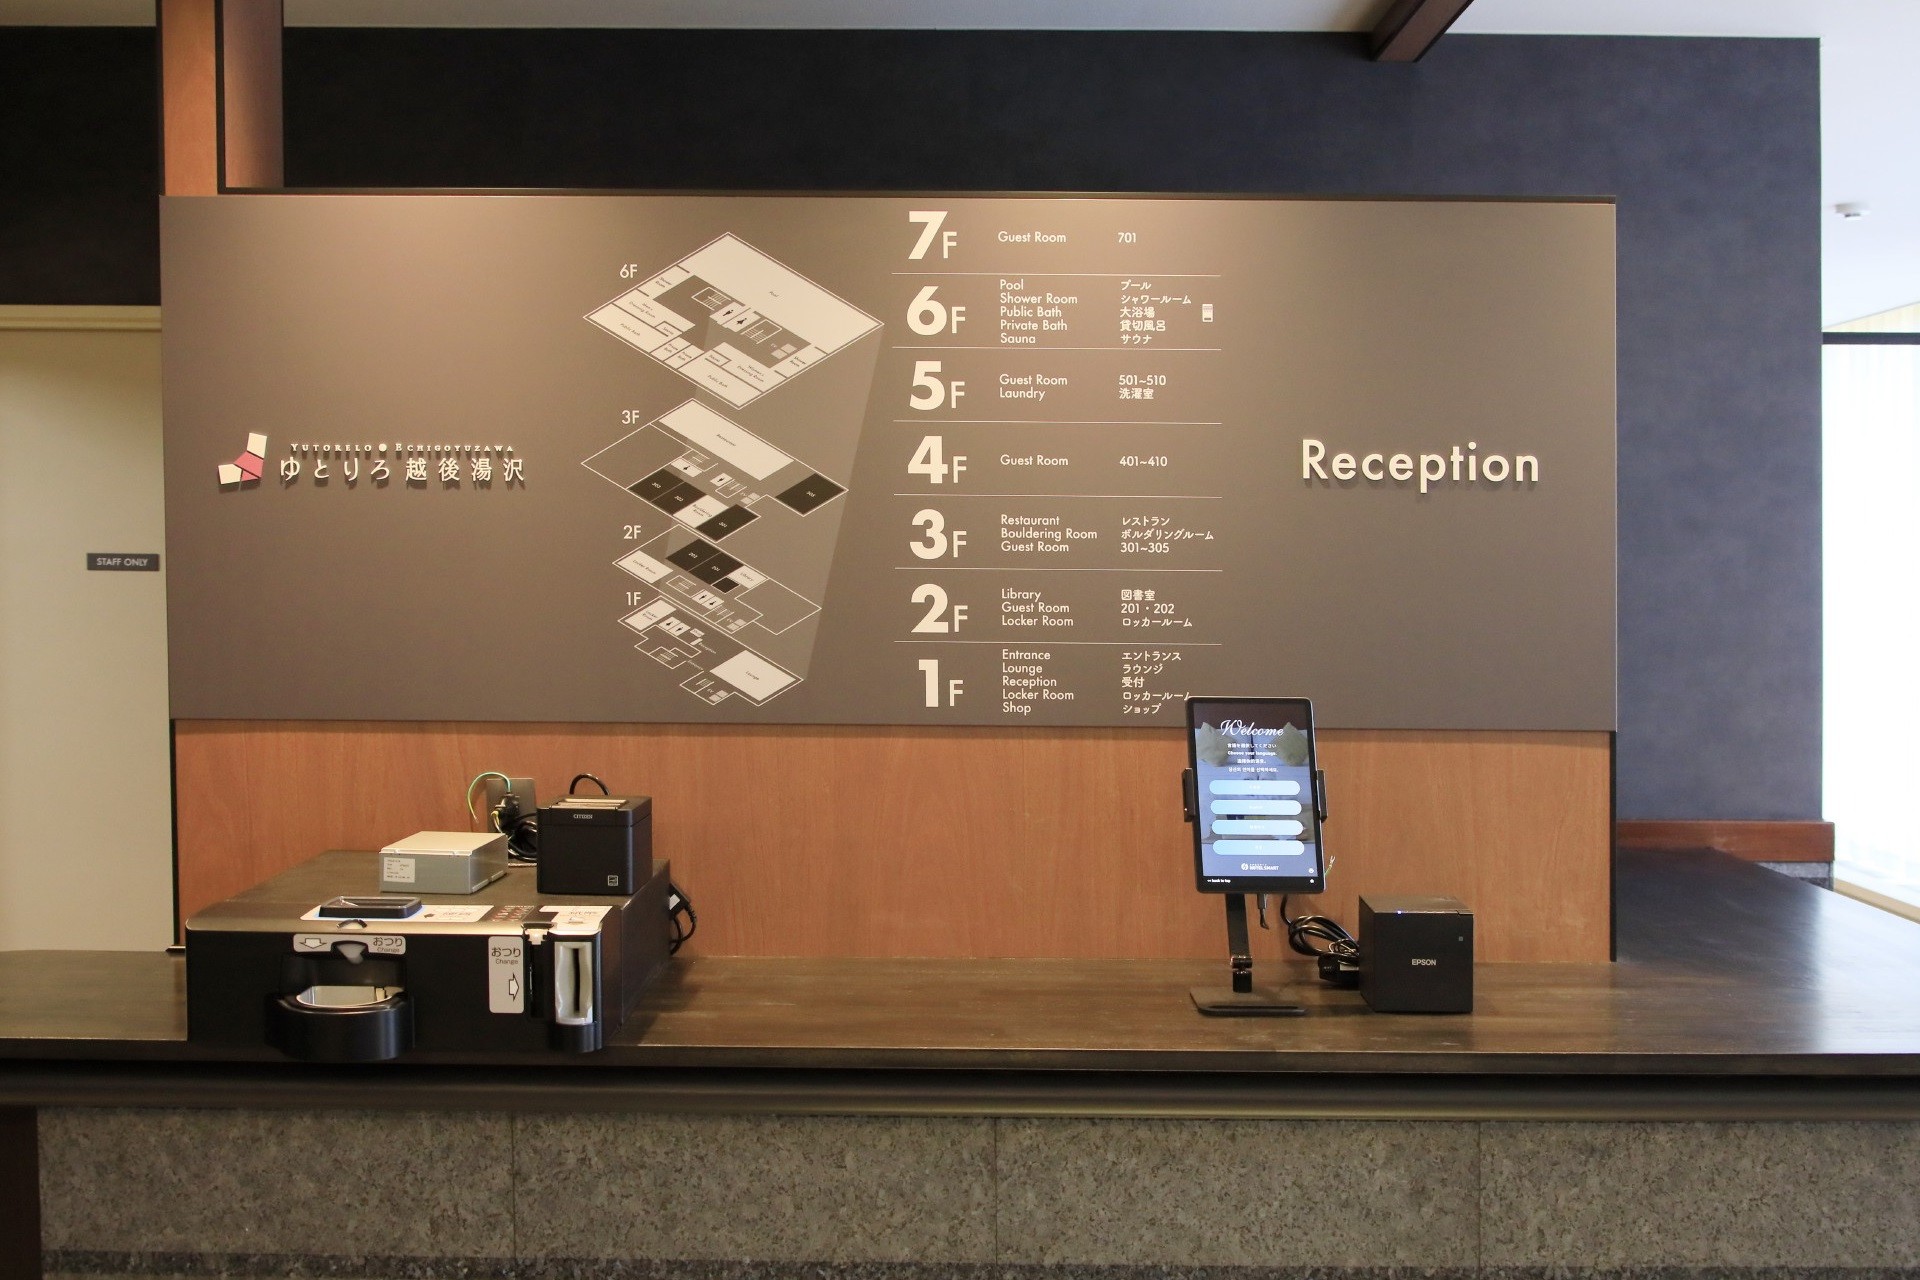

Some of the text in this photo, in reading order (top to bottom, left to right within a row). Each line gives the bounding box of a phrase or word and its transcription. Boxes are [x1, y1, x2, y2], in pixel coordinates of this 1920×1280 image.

[908, 211, 957, 259] 7F
[998, 231, 1066, 242] Guest Room
[1118, 232, 1136, 243] 701
[620, 264, 637, 278] 6F
[1000, 279, 1023, 290] Pool
[1121, 279, 1151, 290] プール
[1000, 292, 1077, 303] Shower Room
[1121, 295, 1191, 304] シャワールーム
[907, 286, 965, 335] 6F
[1001, 305, 1062, 317] Public Bath
[1120, 306, 1155, 318] 大浴場
[1001, 319, 1067, 330] Private Bath
[1120, 319, 1165, 331] 貸切風呂
[1001, 333, 1035, 343] Sauna
[1121, 334, 1152, 344] サウナ
[1000, 374, 1067, 385] Guest Room
[910, 361, 965, 410] 5F
[1000, 387, 1045, 401] Laundry
[1119, 388, 1153, 399] 洗濯室
[622, 410, 639, 424] 3F
[908, 436, 967, 483] 4F
[1001, 454, 1068, 465] Guest Room
[1302, 439, 1539, 493] Reception
[1001, 514, 1059, 525] Restaurant
[1123, 516, 1169, 526] レストラン
[624, 525, 641, 539] 2F
[910, 509, 966, 559] 3F
[1002, 527, 1097, 542] Bouldering Room
[1121, 528, 1213, 540] ボルダリングルーム
[1001, 540, 1069, 552] Guest Room
[96, 558, 148, 566] STAFF ONLY
[626, 592, 641, 606] 1F
[1002, 588, 1042, 603] Library
[1121, 589, 1155, 600] 図書室
[911, 584, 968, 633] 2F
[1002, 601, 1069, 612] Guest Room
[1002, 614, 1073, 626] Locker Room
[1123, 617, 1192, 627] ロッカールーム
[1003, 649, 1050, 659] Entrance
[1122, 651, 1181, 661] エントランス
[1003, 662, 1042, 677] Lounge
[1123, 663, 1163, 674] ラウンジ
[919, 659, 963, 707] 1F
[1003, 675, 1056, 690] Reception
[1122, 677, 1144, 687] 受付
[1003, 688, 1073, 699] Locker Room
[1003, 702, 1031, 715] Shop
[1123, 703, 1161, 714] ショップ
[1221, 720, 1284, 736] Welcome
[372, 937, 402, 946] おつり
[492, 947, 521, 957] おつり
